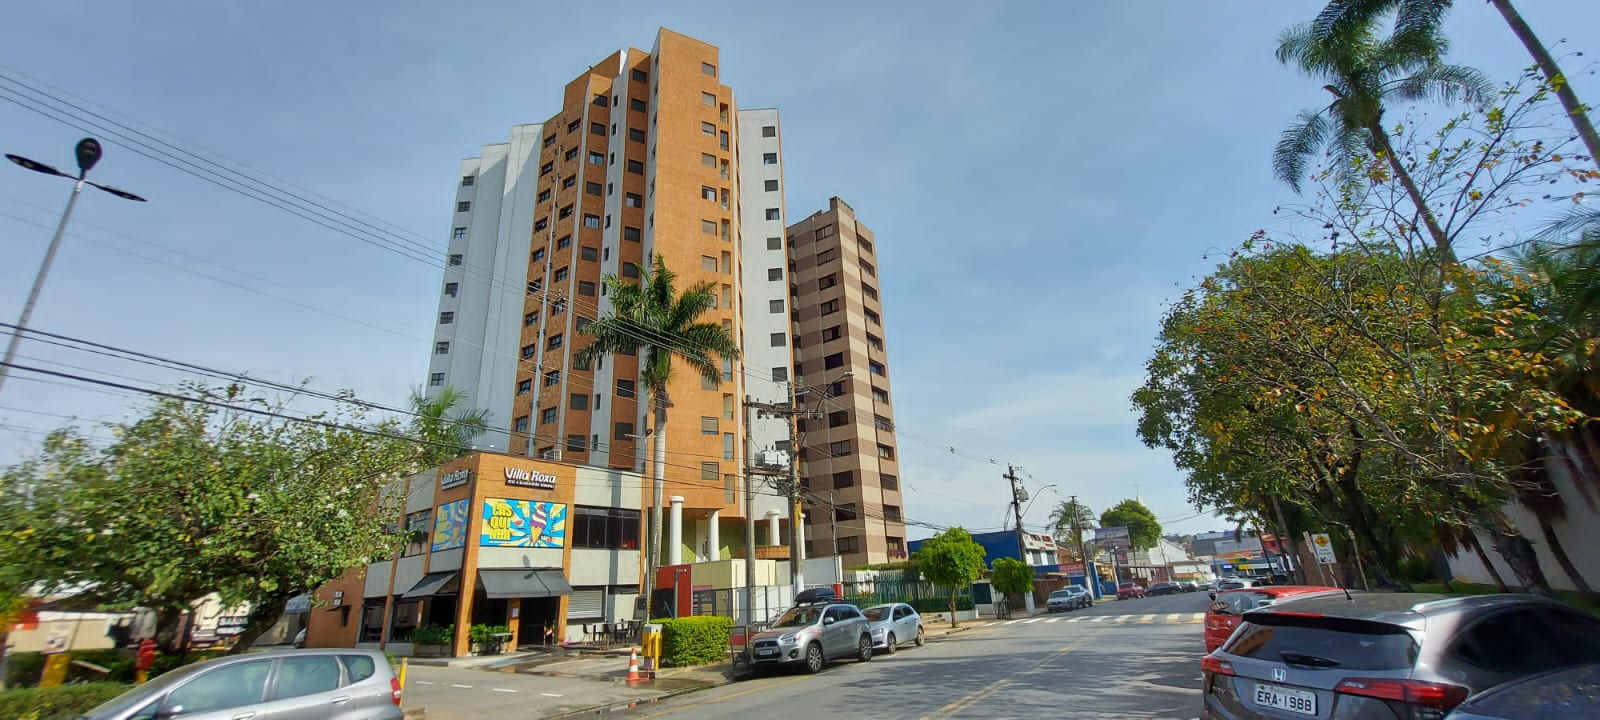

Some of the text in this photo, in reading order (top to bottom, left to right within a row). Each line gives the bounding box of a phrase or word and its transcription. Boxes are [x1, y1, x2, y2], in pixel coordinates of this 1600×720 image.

[505, 467, 556, 483] Villa Roxa
[490, 516, 511, 529] QUI
